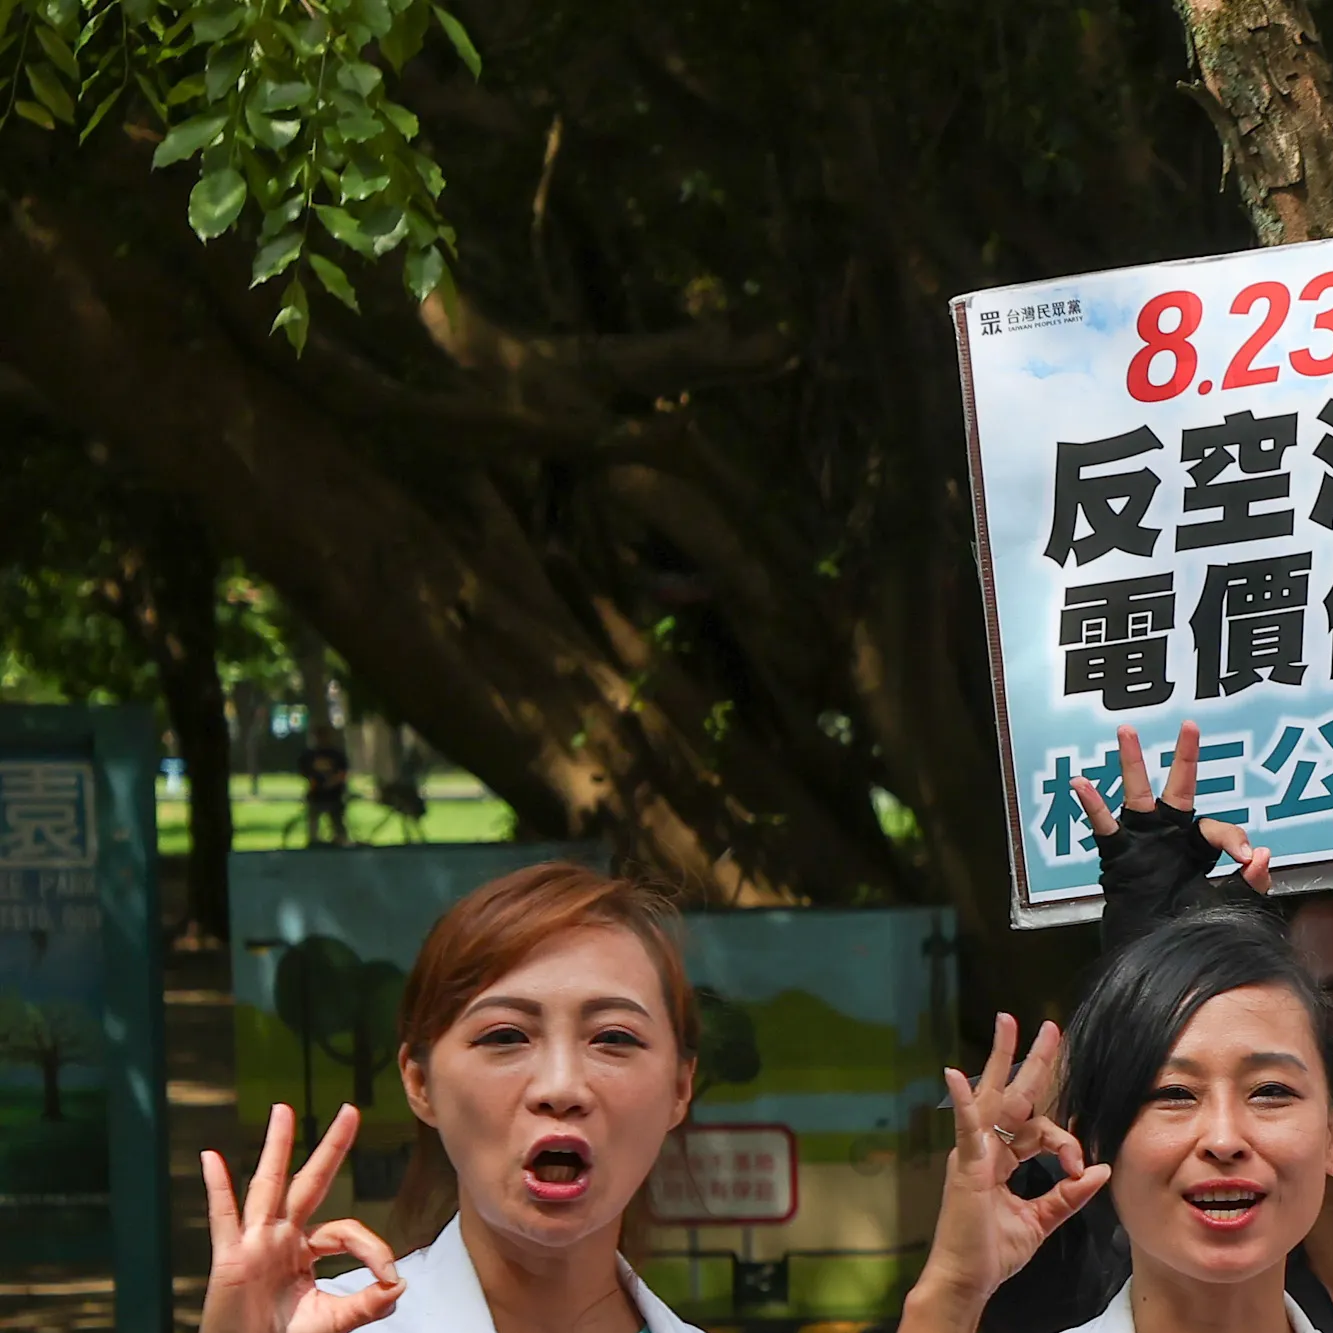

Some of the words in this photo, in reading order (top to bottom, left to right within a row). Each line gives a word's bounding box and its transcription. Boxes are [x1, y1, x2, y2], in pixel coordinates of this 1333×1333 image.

[1007, 299, 1082, 324] 台灣民眾黨
